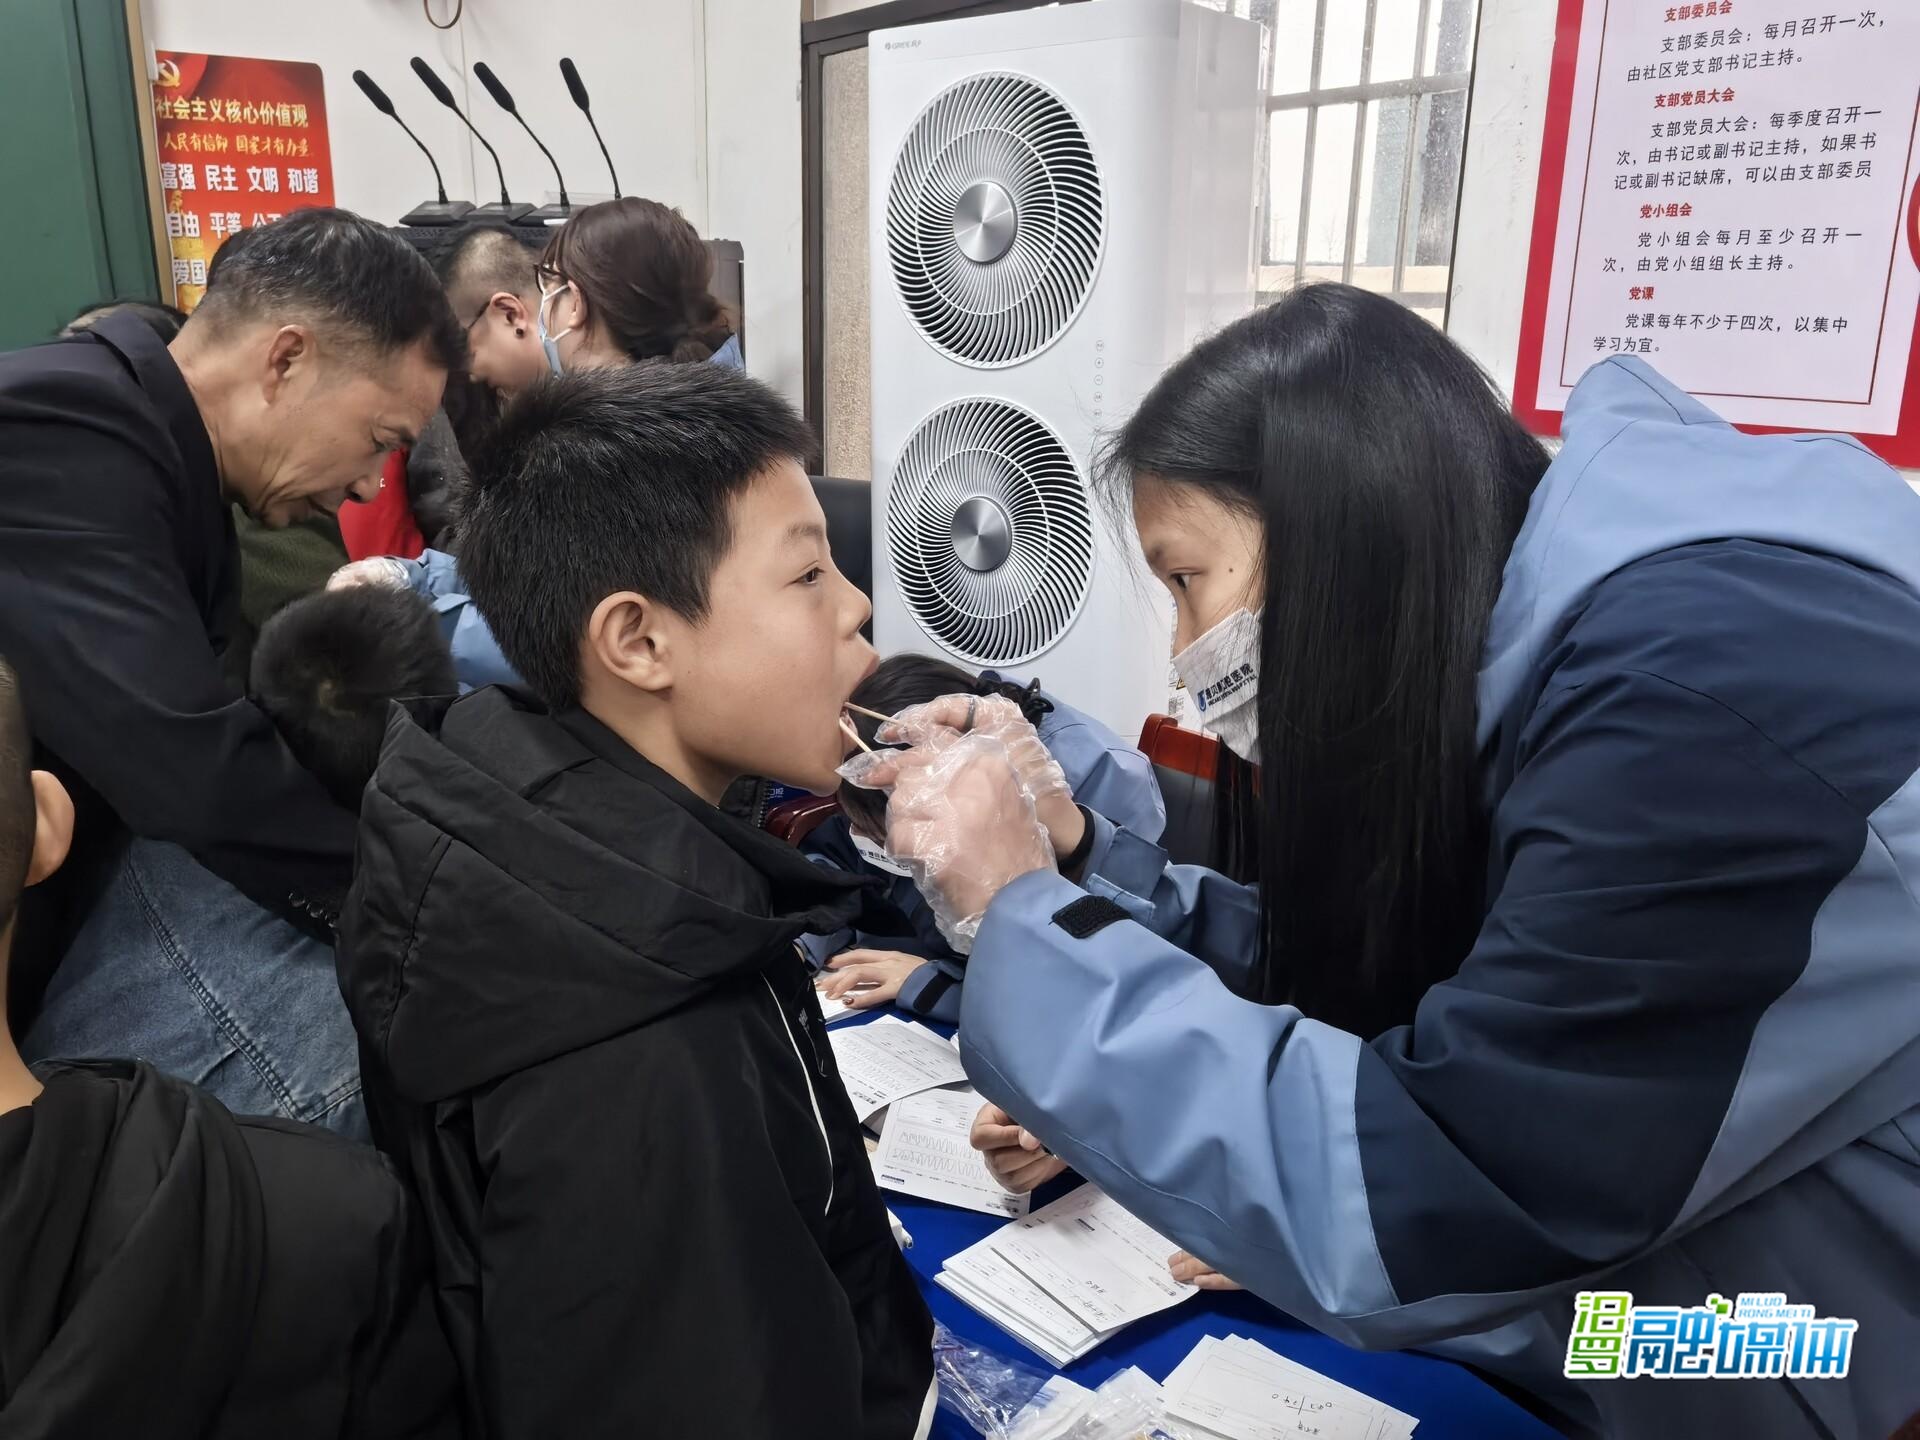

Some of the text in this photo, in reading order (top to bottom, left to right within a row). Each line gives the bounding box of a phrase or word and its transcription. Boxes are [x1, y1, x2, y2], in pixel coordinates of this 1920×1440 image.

[1664, 0, 1733, 22] 支部委员会
[1627, 47, 1804, 83] 由社区党支部书记主持。
[1654, 87, 1735, 109] 支部党员大会
[156, 95, 309, 128] 社会主义核心价值观
[164, 132, 228, 153] 人民有信仰
[161, 162, 319, 193] 富强 民主 文明 和谐
[1640, 202, 1692, 218] 党小组会
[167, 211, 200, 237] 自由
[209, 212, 242, 239] 平等
[1638, 227, 1862, 247] 党小组会每月至少召开一
[173, 259, 207, 285] 爱国
[1629, 286, 1655, 301] 党课
[1593, 336, 1661, 353] 学习为宜。
